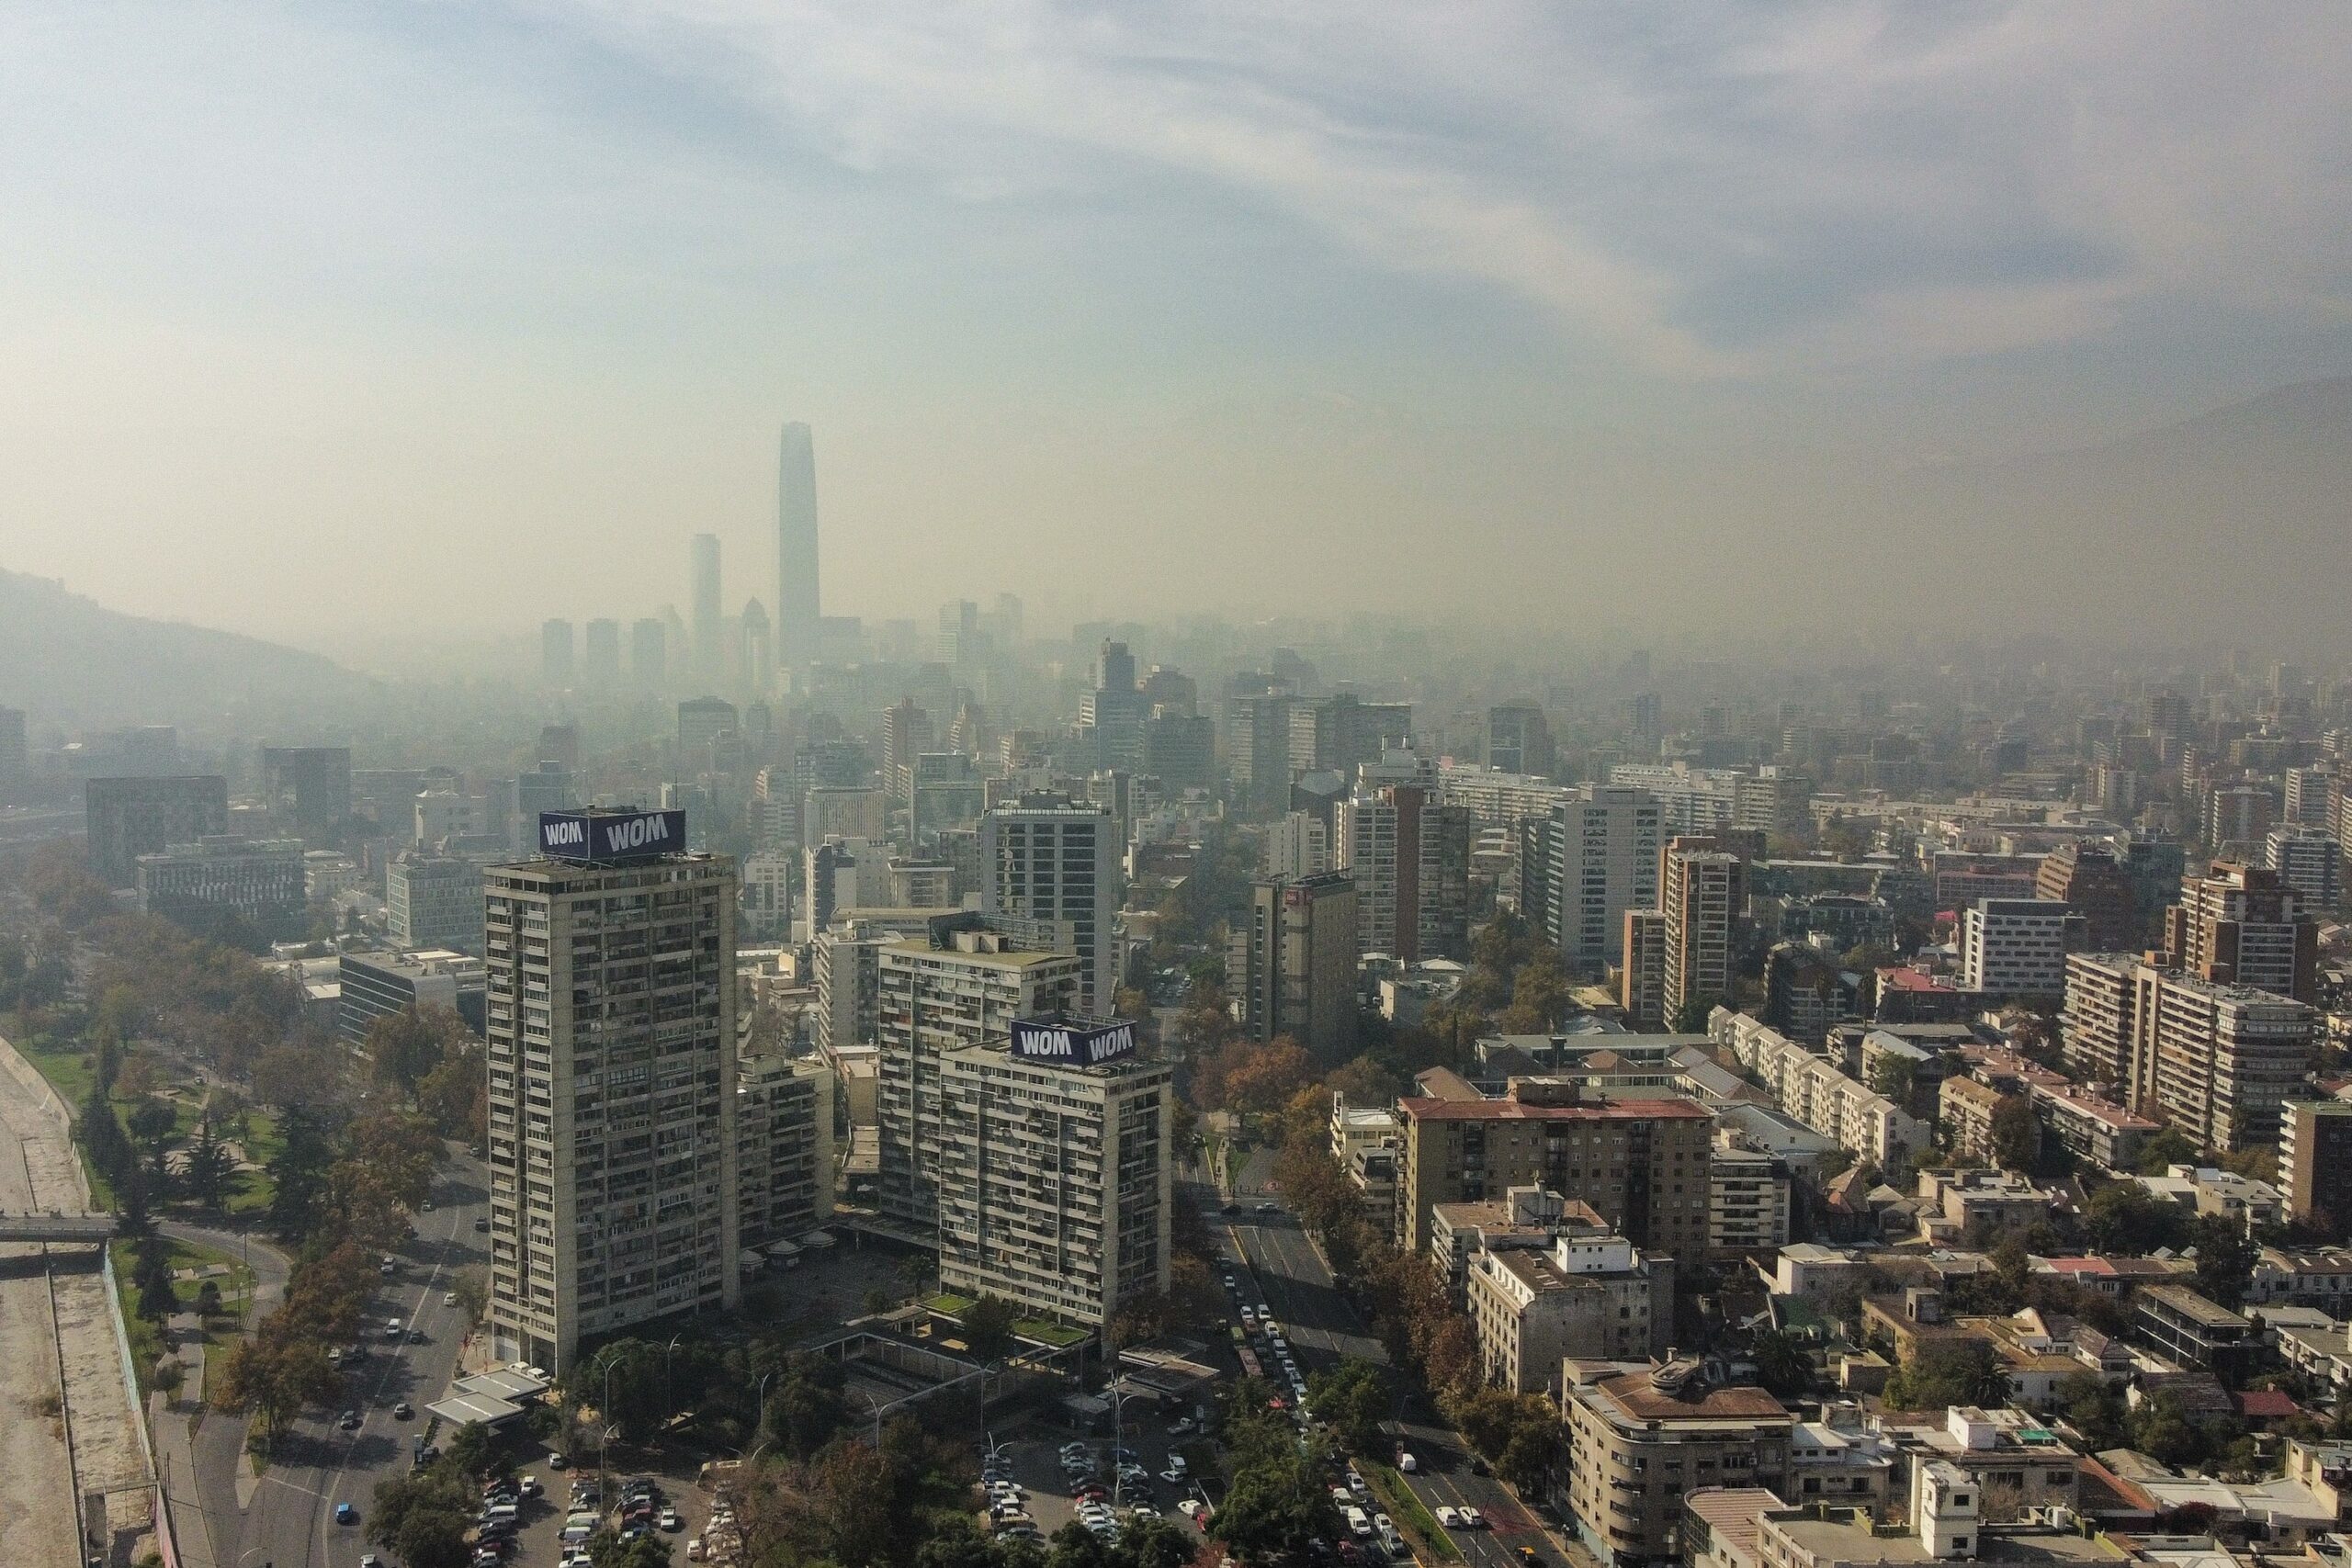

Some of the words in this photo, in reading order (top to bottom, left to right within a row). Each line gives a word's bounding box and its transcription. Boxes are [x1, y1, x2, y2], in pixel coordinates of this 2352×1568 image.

[545, 821, 583, 846] WOM
[606, 814, 669, 852] WOM
[1020, 1031, 1072, 1055] WOM
[1089, 1025, 1133, 1062] WOM
